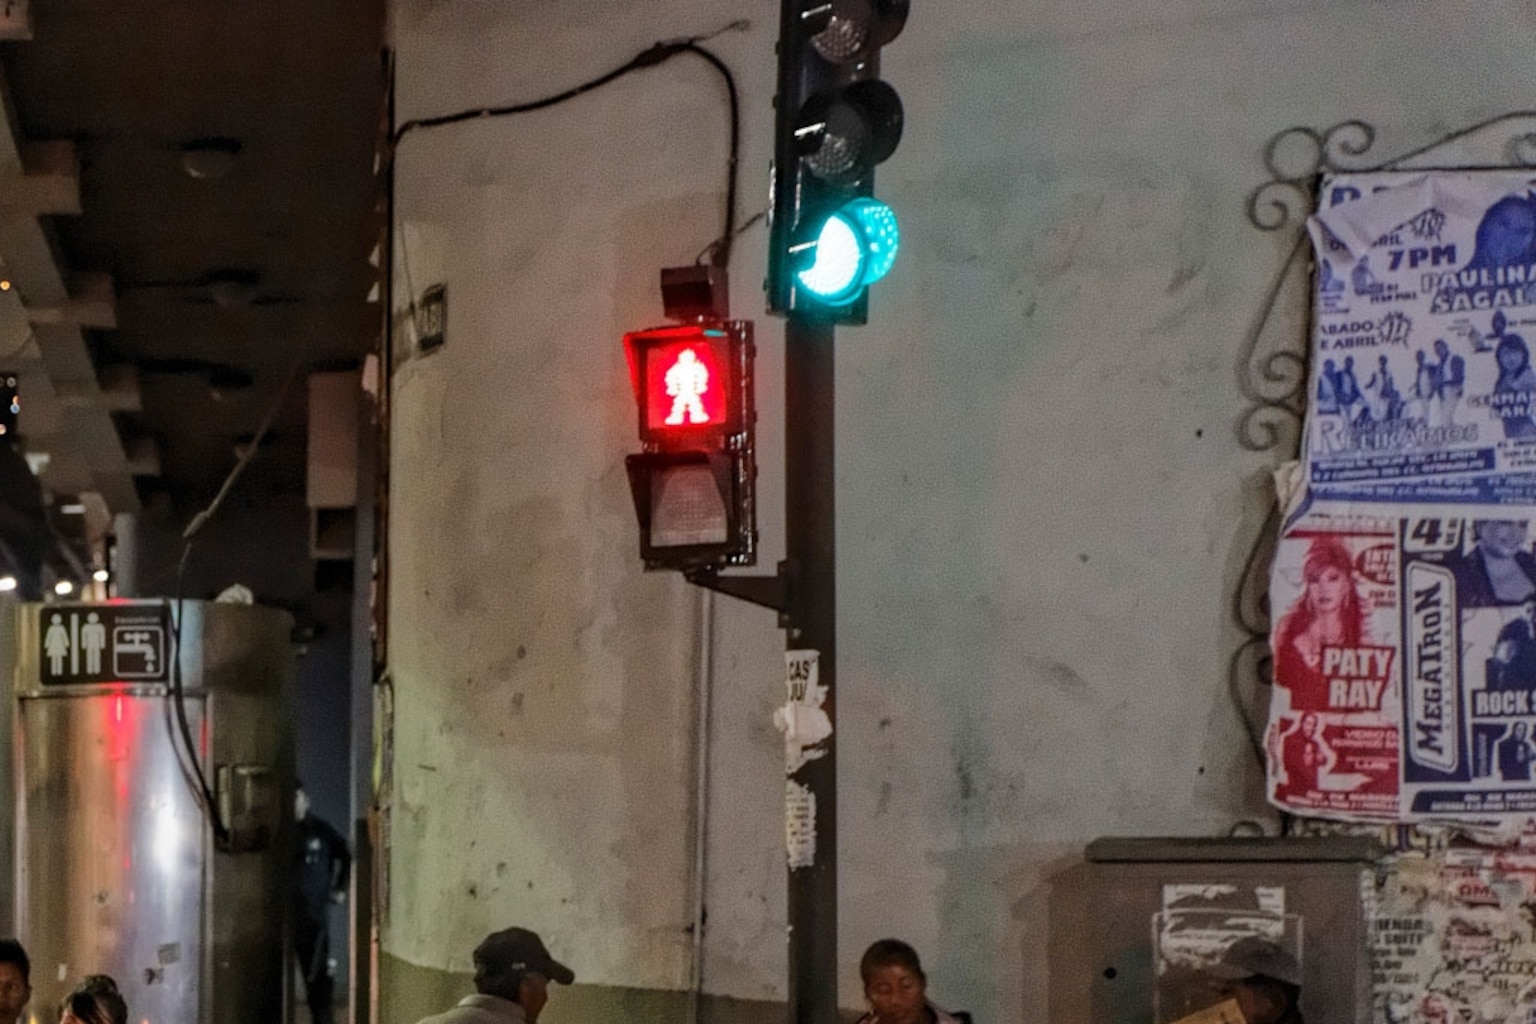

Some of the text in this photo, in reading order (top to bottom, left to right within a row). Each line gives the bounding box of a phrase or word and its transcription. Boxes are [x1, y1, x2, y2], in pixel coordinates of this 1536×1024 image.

[1323, 648, 1392, 677] PATY
[1329, 680, 1383, 708] RAY
[1475, 689, 1529, 716] ROCK
